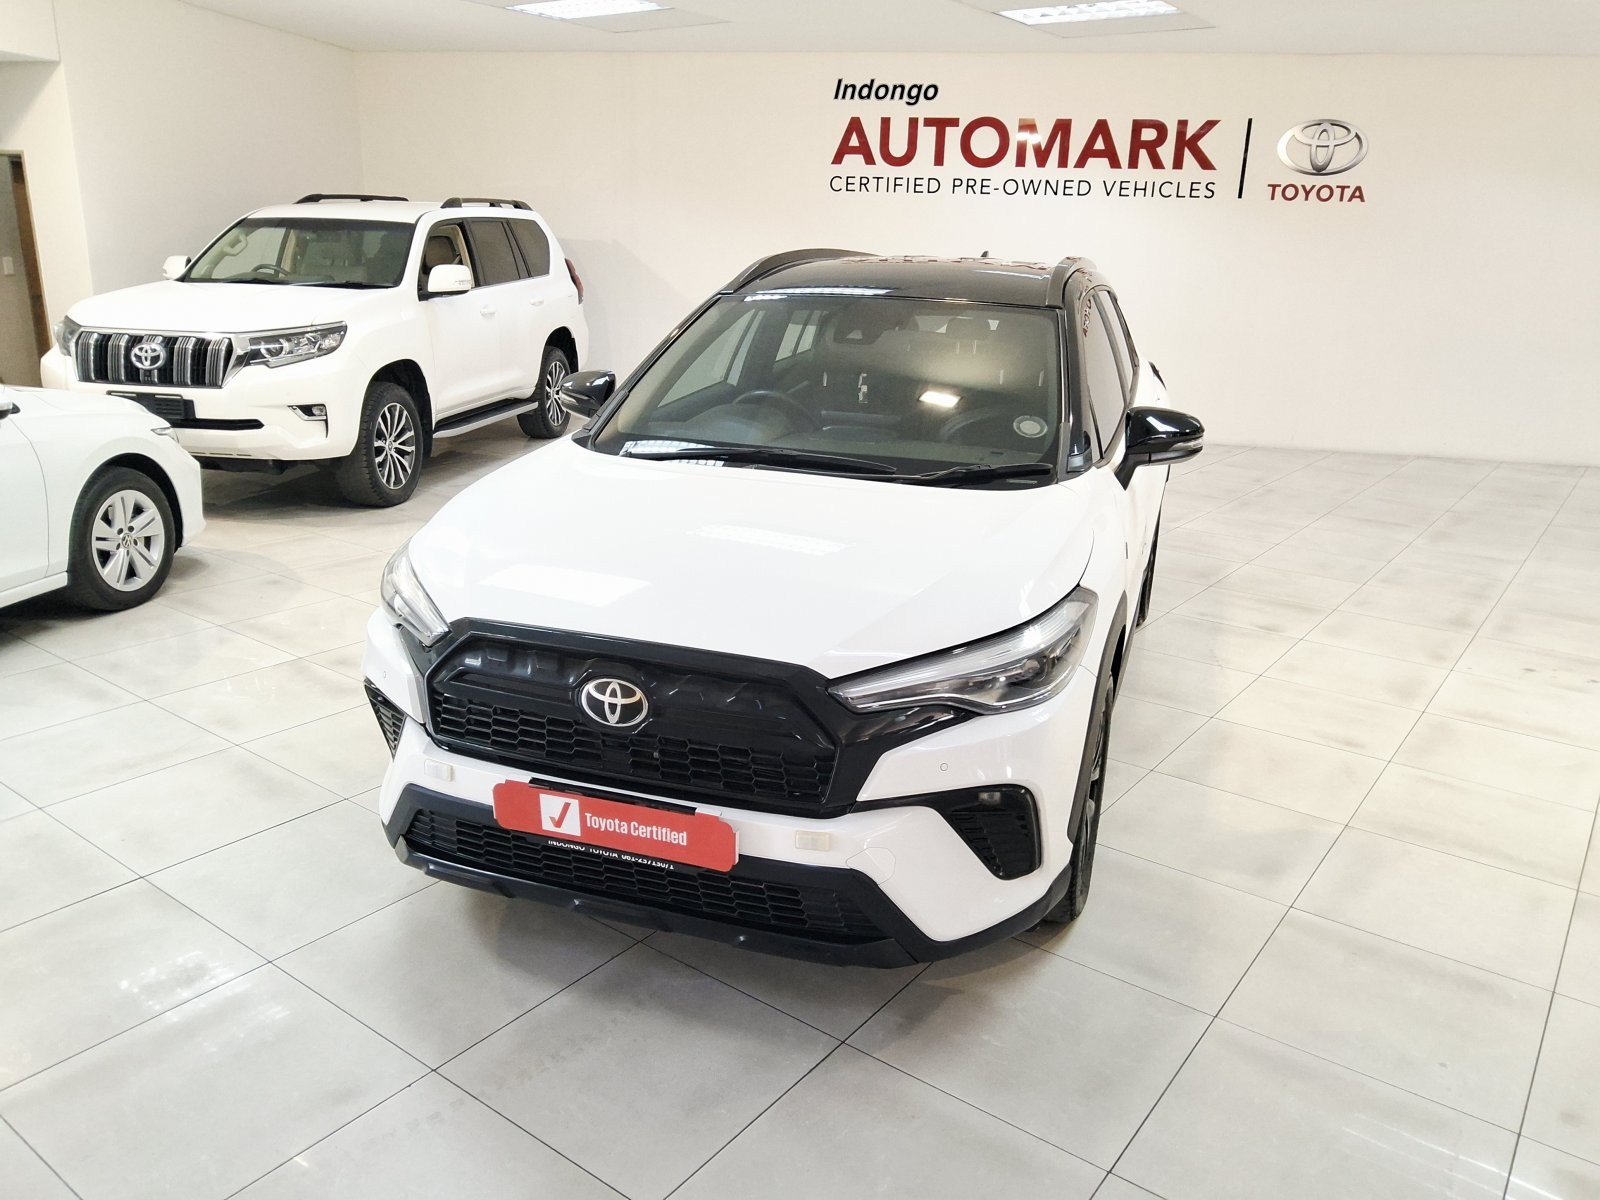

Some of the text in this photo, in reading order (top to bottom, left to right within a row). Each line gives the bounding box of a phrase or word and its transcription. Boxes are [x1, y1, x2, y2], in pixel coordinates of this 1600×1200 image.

[834, 78, 939, 106] Indongo
[831, 116, 1222, 171] AUTOMARK
[829, 175, 1216, 199] CERTIFIED PRE-OWNED VEHICLES
[1267, 183, 1366, 203] TOYOTA
[584, 812, 688, 846] Toyota Certified
